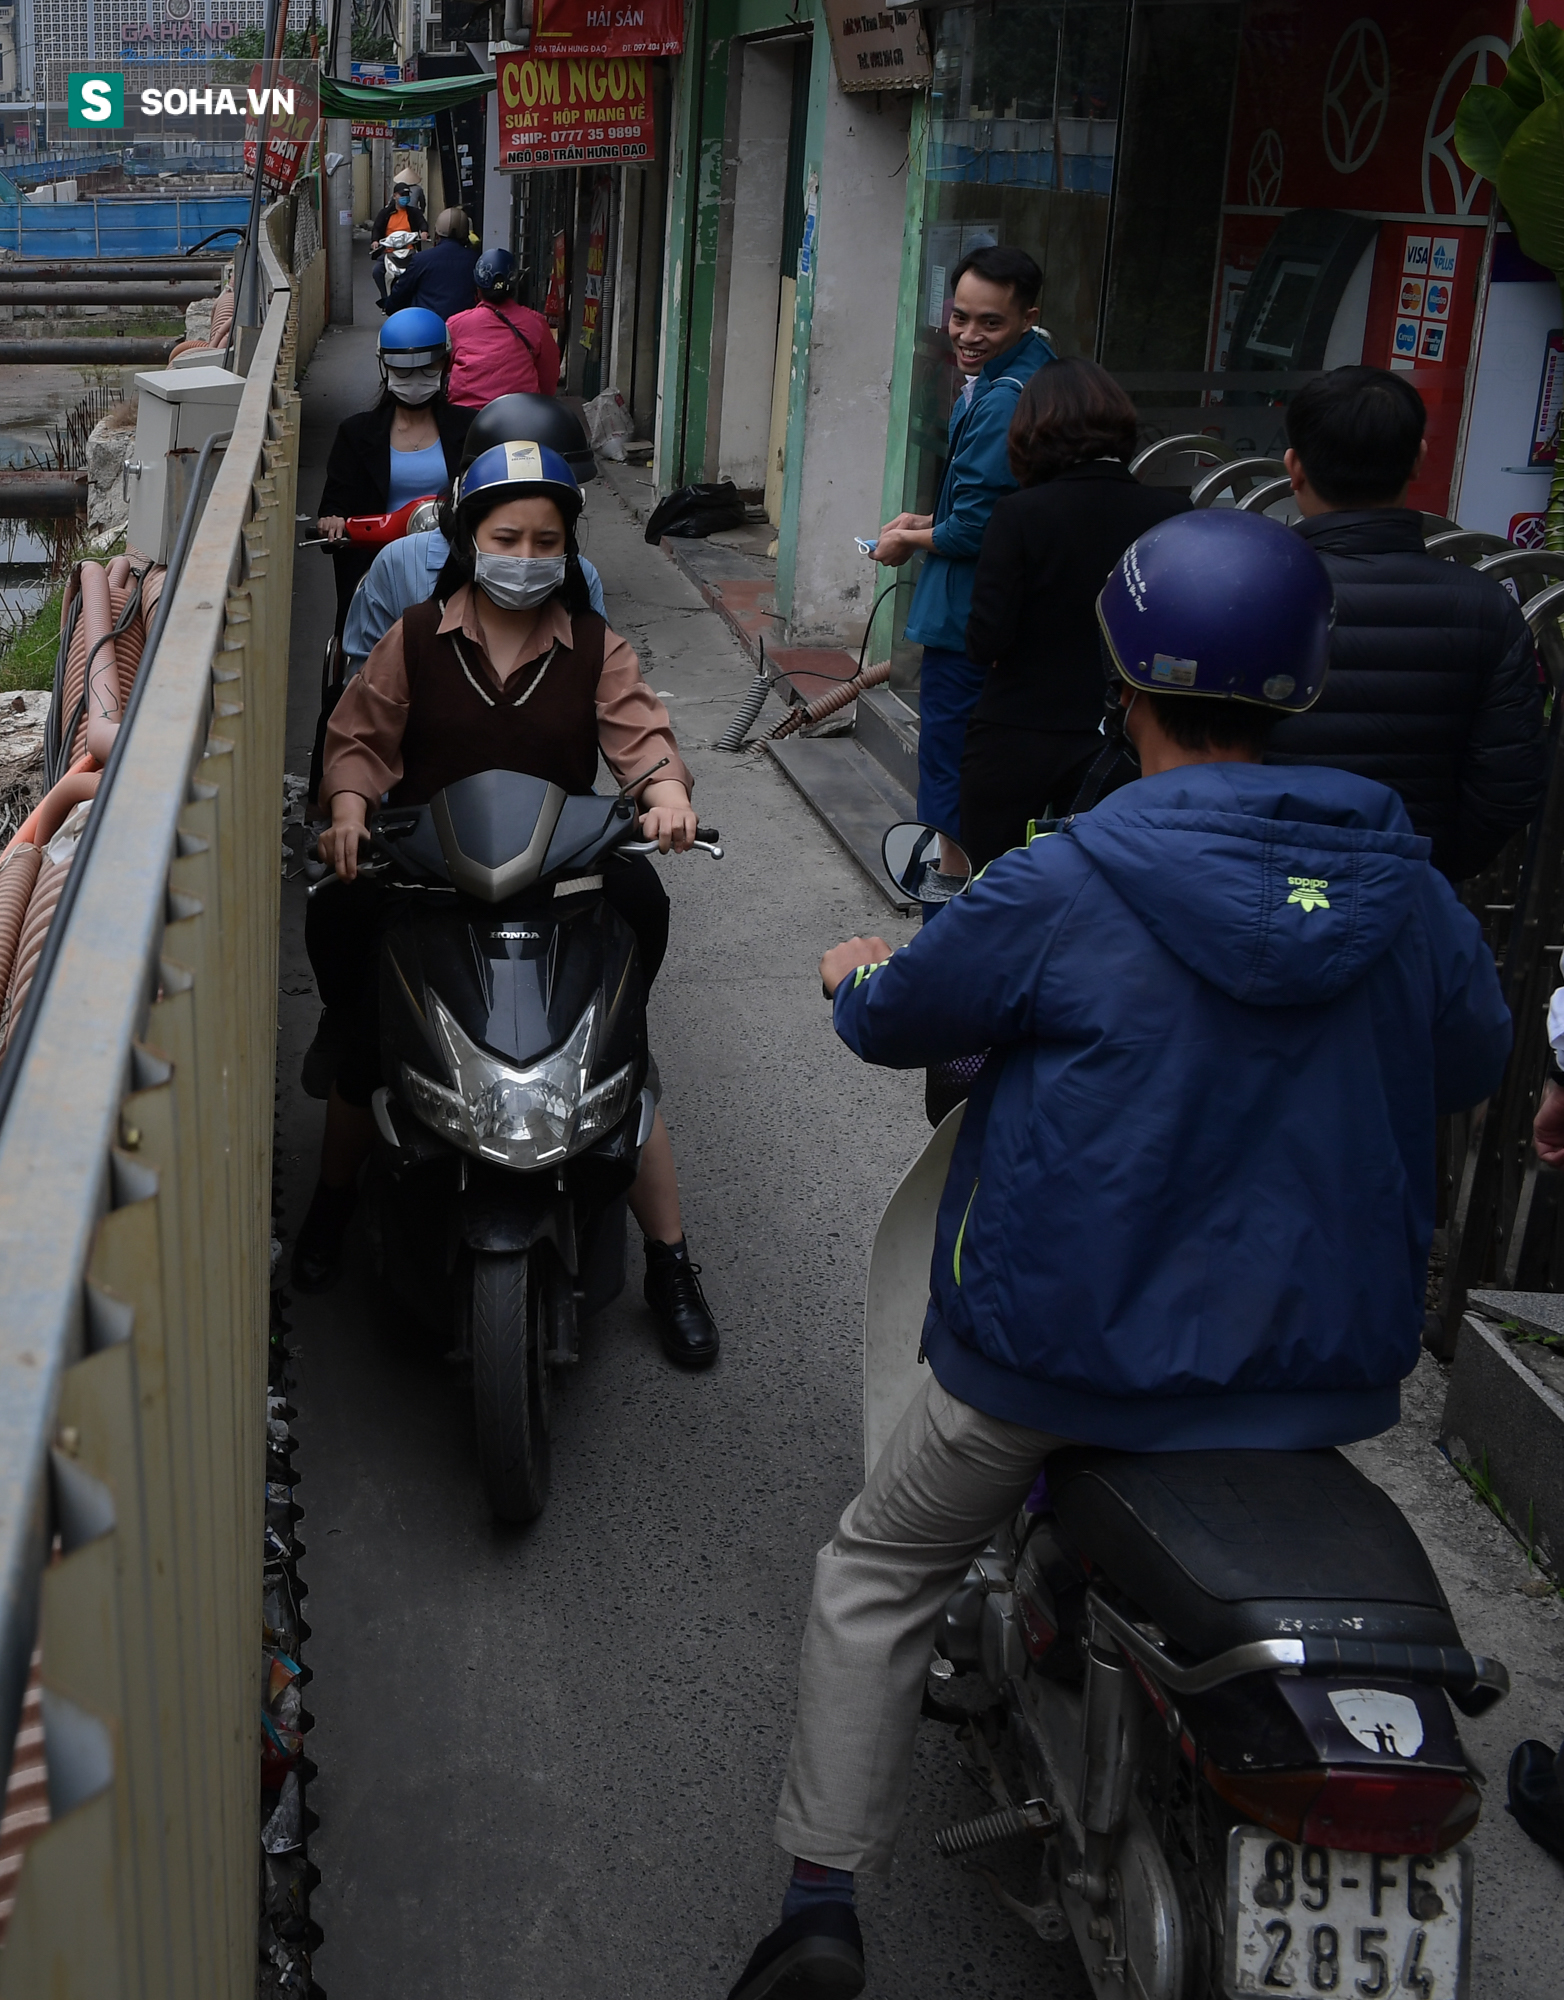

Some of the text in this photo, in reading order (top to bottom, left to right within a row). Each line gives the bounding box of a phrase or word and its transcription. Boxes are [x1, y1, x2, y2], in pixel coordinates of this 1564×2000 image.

[586, 5, 644, 27] HẢI SẢN
[122, 23, 155, 40] GA
[161, 19, 194, 40] HÀ
[503, 57, 646, 108] CƠM NGON
[505, 108, 539, 129] SUẤT
[553, 108, 580, 128] HỘP
[584, 106, 625, 122] MANG
[511, 125, 641, 145] SHIP: 0777 35 9899
[535, 149, 550, 162] 98
[587, 145, 619, 159] HƯNG
[622, 143, 646, 158] ĐẠO
[1407, 246, 1428, 264] VISA
[1437, 257, 1454, 271] PLUS
[1287, 876, 1329, 889] adidas
[490, 931, 541, 939] HONDA
[1260, 1917, 1434, 1999] 2854
